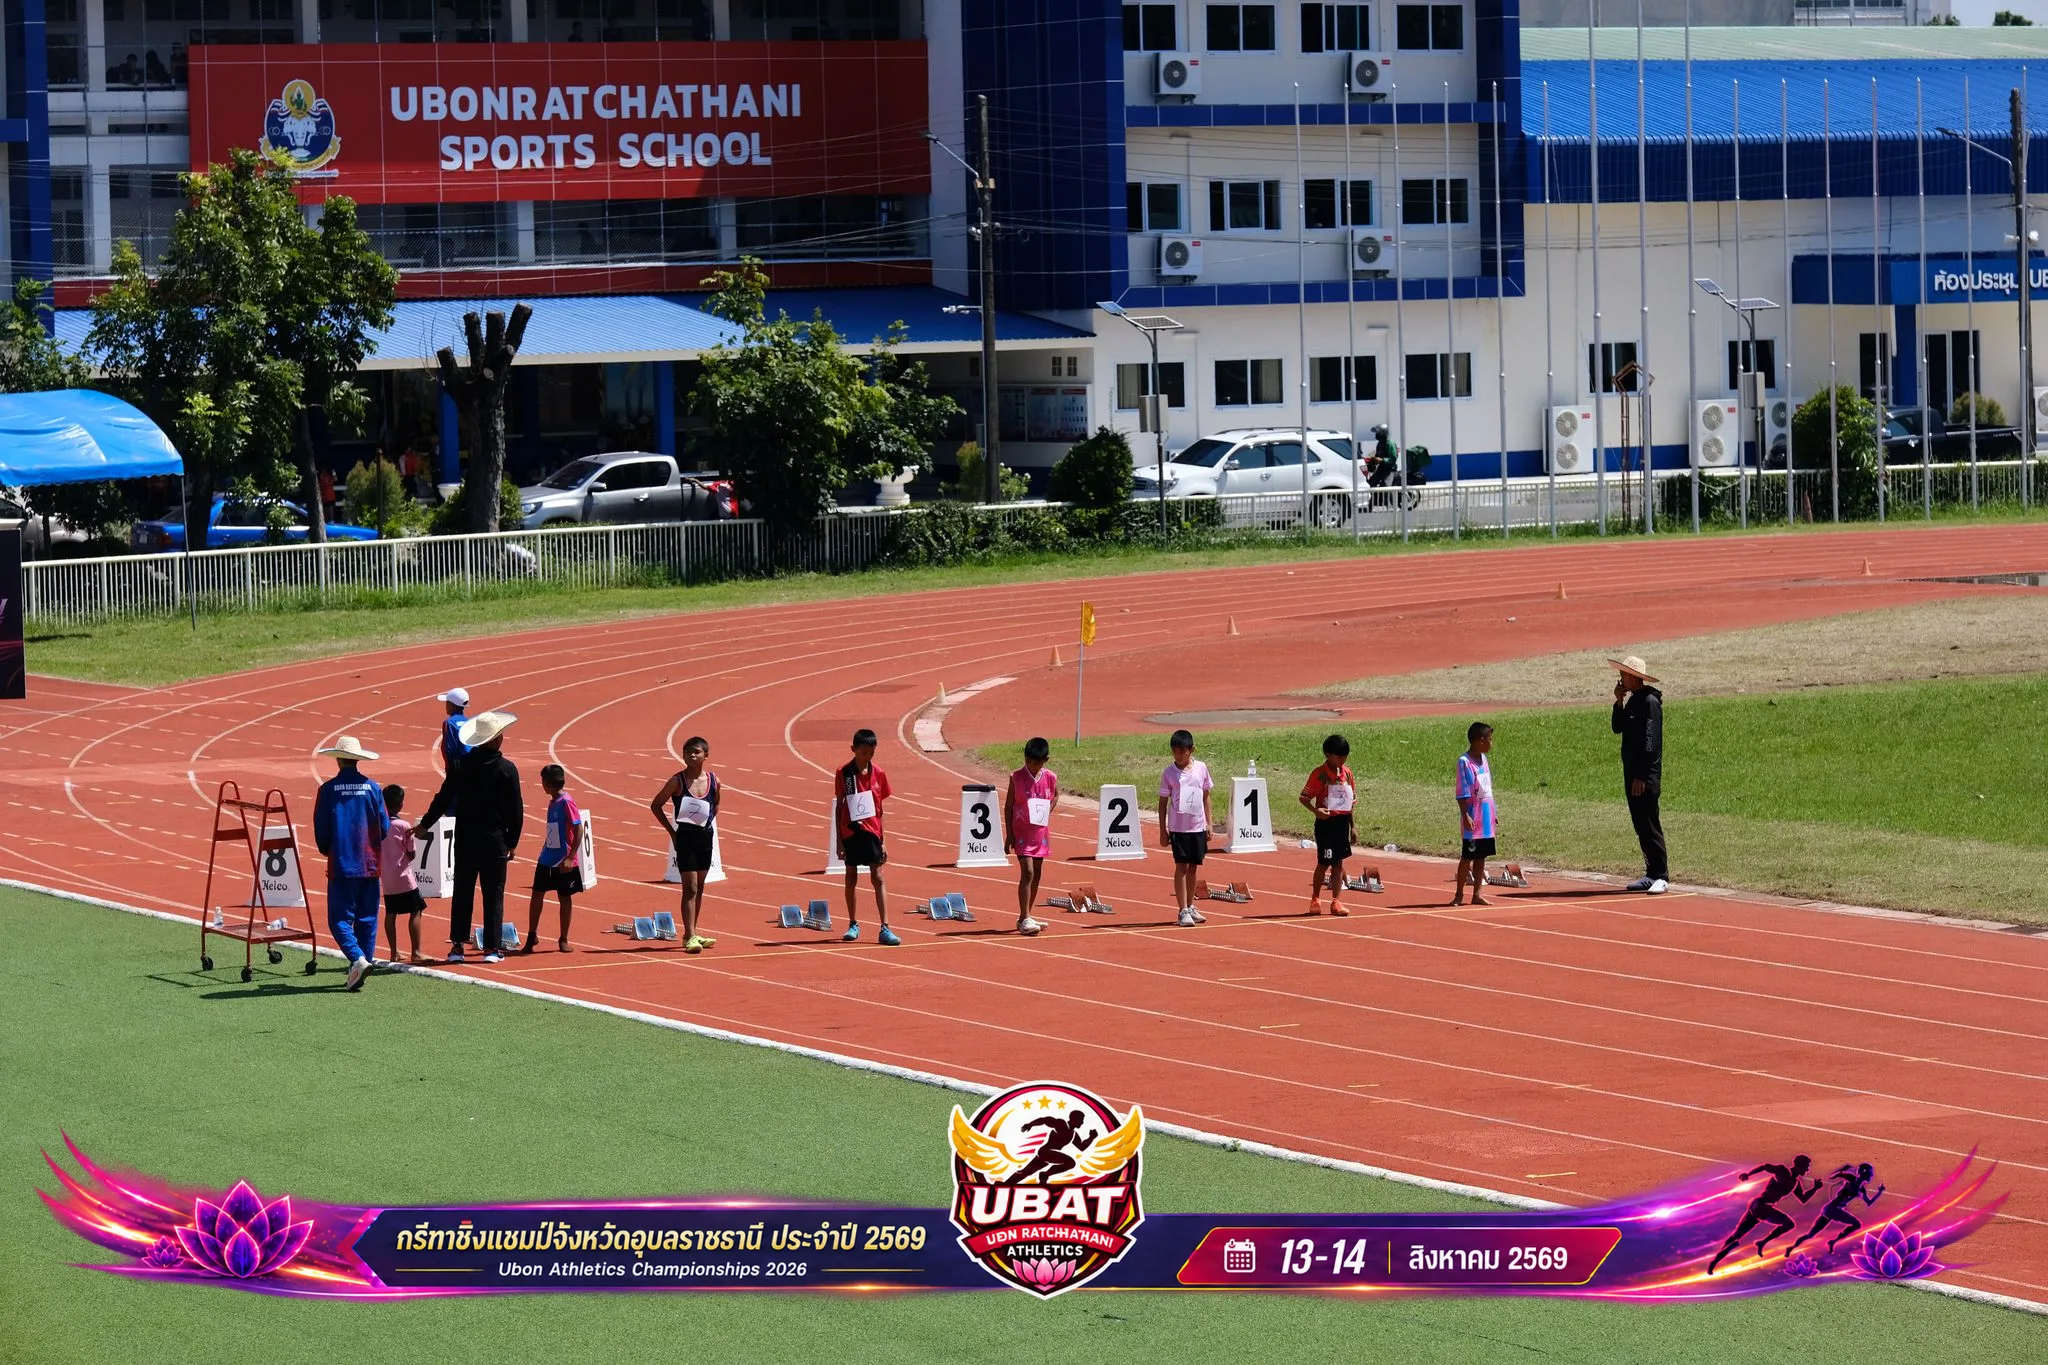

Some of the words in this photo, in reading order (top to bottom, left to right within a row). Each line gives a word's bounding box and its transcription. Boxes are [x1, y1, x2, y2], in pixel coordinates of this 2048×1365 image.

[391, 83, 801, 121] UBONRATCHATHANI
[441, 134, 596, 171] SPORTS
[619, 132, 772, 168] SCHOOL
[857, 796, 866, 814] 6
[970, 803, 992, 840] 3
[1107, 798, 1130, 834] 2
[1244, 789, 1259, 826] 1
[415, 831, 434, 869] 7
[444, 829, 453, 868] 7
[583, 820, 591, 858] 6
